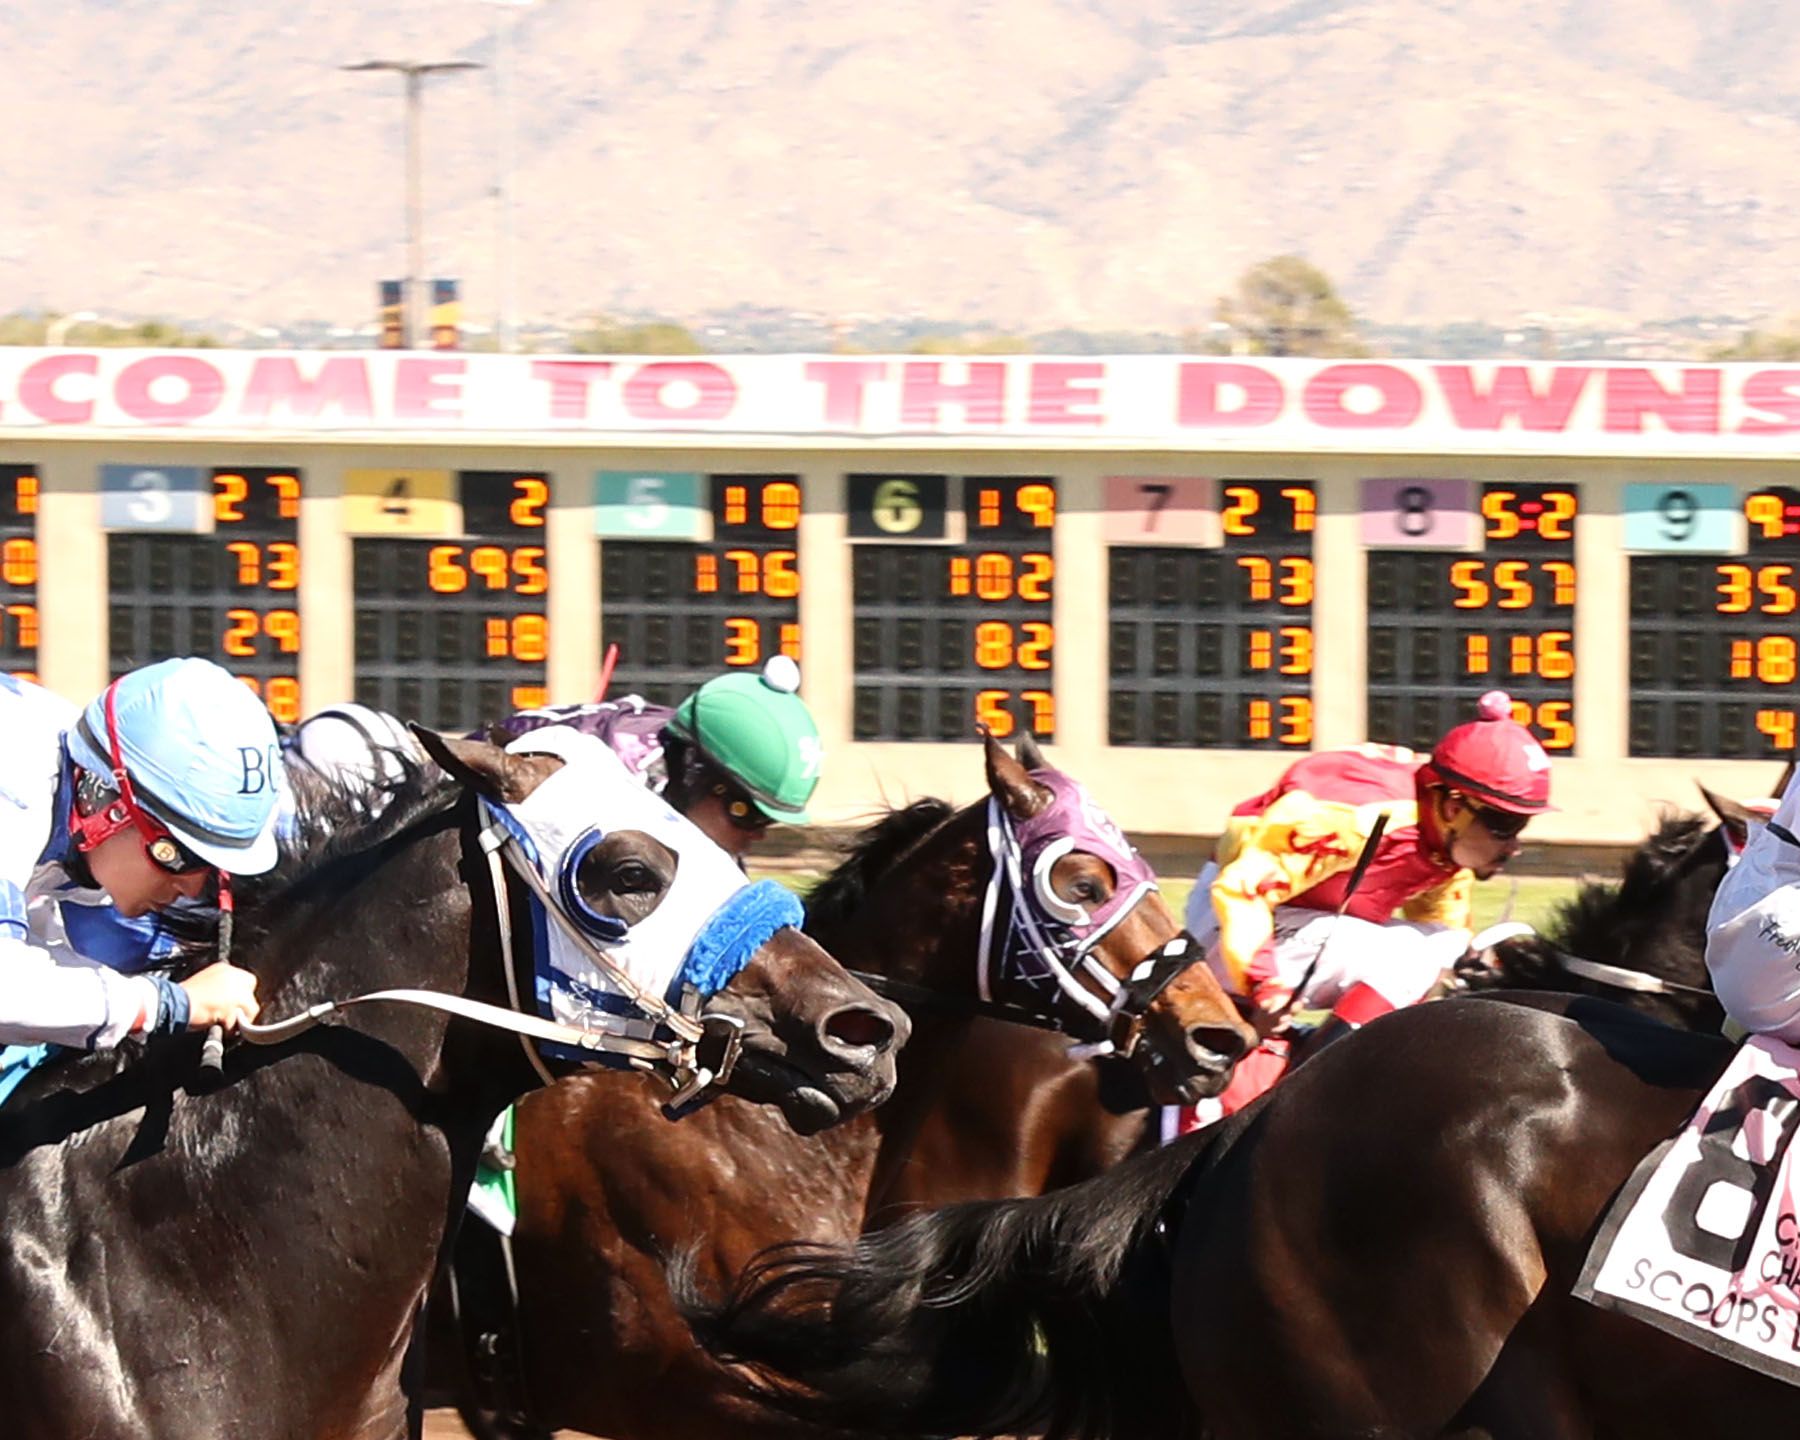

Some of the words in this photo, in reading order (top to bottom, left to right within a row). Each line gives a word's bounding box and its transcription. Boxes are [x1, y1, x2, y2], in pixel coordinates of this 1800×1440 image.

[0, 354, 468, 425] COME
[531, 361, 738, 420] TO
[804, 361, 1107, 425] THE
[127, 471, 172, 523] 3
[213, 475, 300, 520] 27
[379, 477, 413, 524] 4
[510, 479, 548, 526] 2
[625, 477, 670, 530] 5
[872, 480, 923, 533] 6
[979, 485, 1056, 528] 19
[1137, 484, 1175, 533] 7
[1221, 488, 1316, 535] 27
[1396, 485, 1435, 537] 8
[1656, 490, 1698, 541] 9
[226, 542, 299, 589] 73
[429, 546, 548, 594] 695
[696, 551, 800, 597] 176
[950, 553, 1054, 601] 102
[1237, 558, 1314, 605] 73
[1450, 561, 1576, 608] 557
[223, 610, 300, 655] 29
[486, 615, 548, 661] 18
[975, 622, 1054, 669] 82
[1250, 628, 1313, 674] 13
[1468, 632, 1576, 678] 116
[1249, 697, 1313, 744] 13
[1626, 1258, 1779, 1342] SCOOPS
